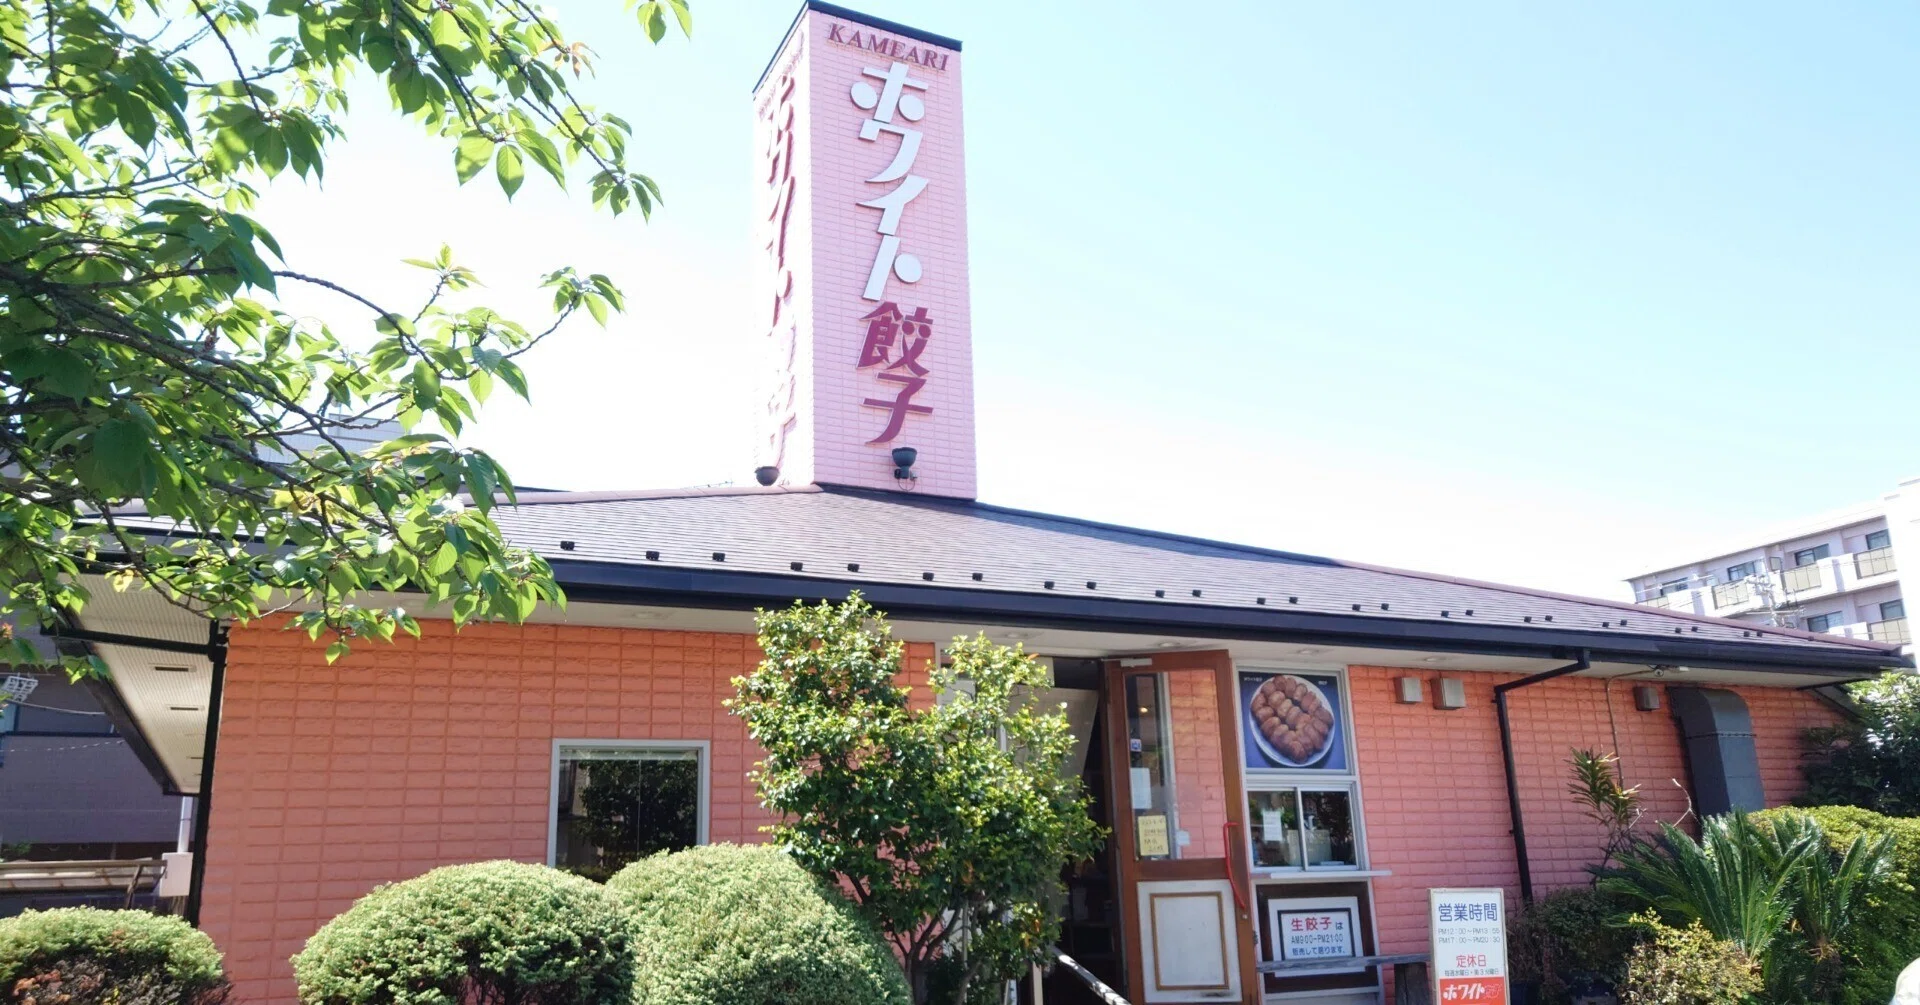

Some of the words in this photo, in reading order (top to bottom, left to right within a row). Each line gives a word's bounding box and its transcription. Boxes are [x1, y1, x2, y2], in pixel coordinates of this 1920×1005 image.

[828, 23, 950, 71] KAMEARI
[1438, 902, 1498, 922] 営業時間
[1456, 954, 1487, 968] 定休日
